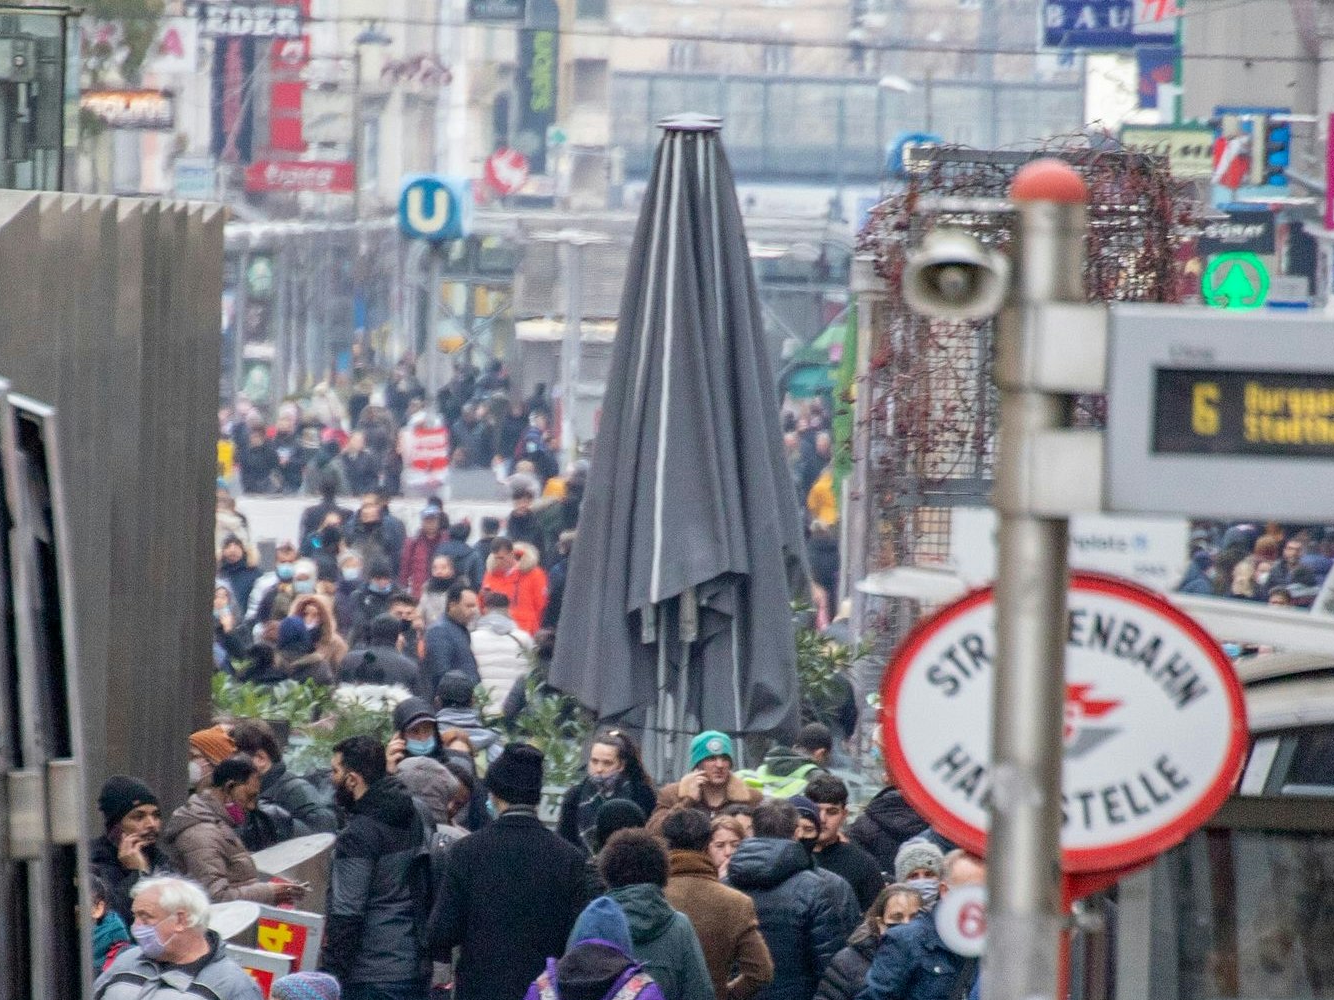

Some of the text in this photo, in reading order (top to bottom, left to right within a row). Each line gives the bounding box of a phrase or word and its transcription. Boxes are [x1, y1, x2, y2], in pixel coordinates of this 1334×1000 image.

[407, 186, 449, 233] U
[1192, 382, 1221, 436] 6
[957, 904, 986, 939] 6
